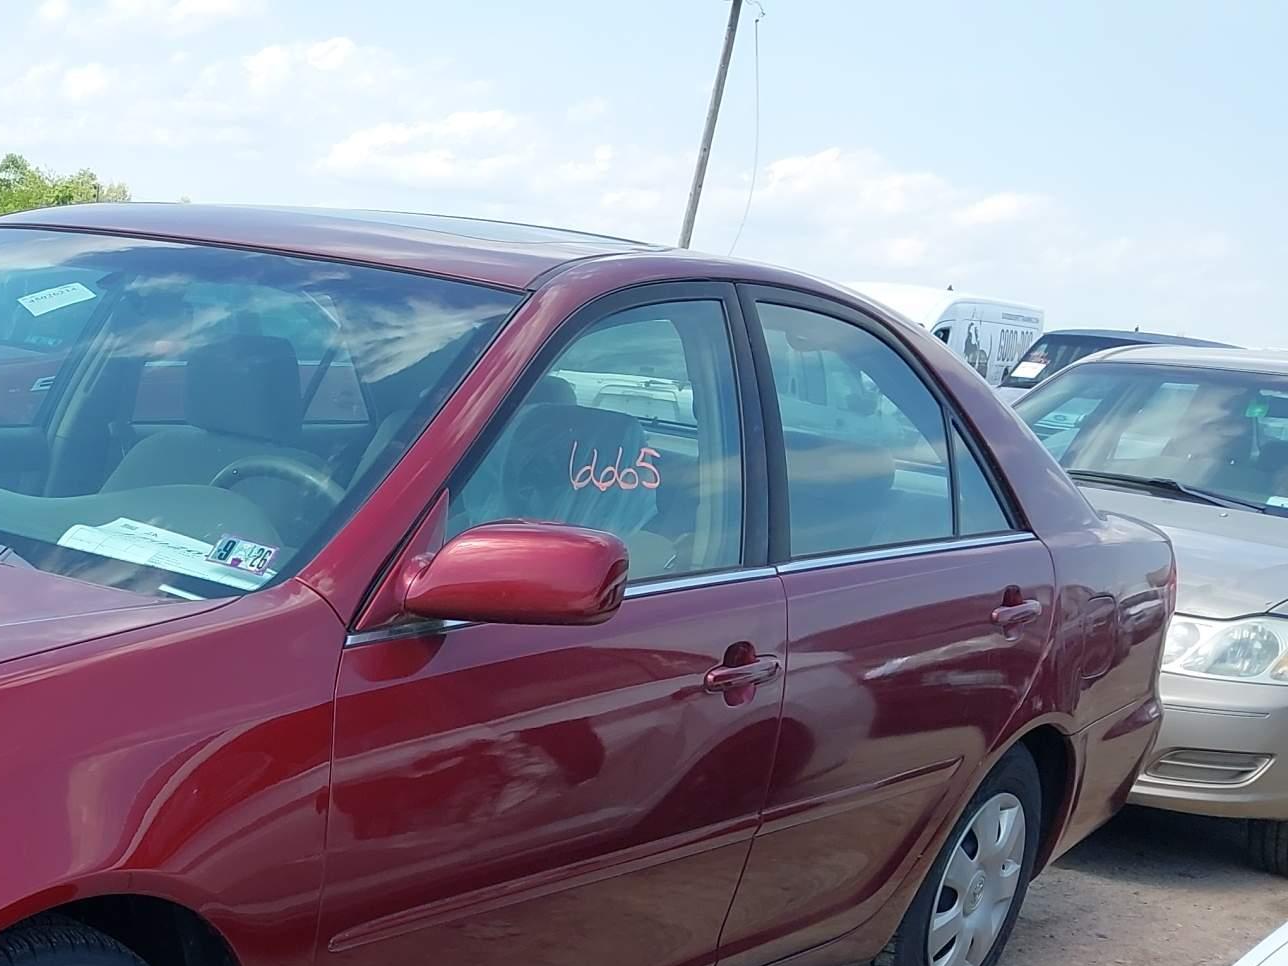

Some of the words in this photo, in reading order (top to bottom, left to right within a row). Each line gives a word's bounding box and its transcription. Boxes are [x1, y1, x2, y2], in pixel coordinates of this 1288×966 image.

[569, 440, 661, 491] 6665
[217, 540, 237, 561] 9
[249, 547, 272, 569] 26
